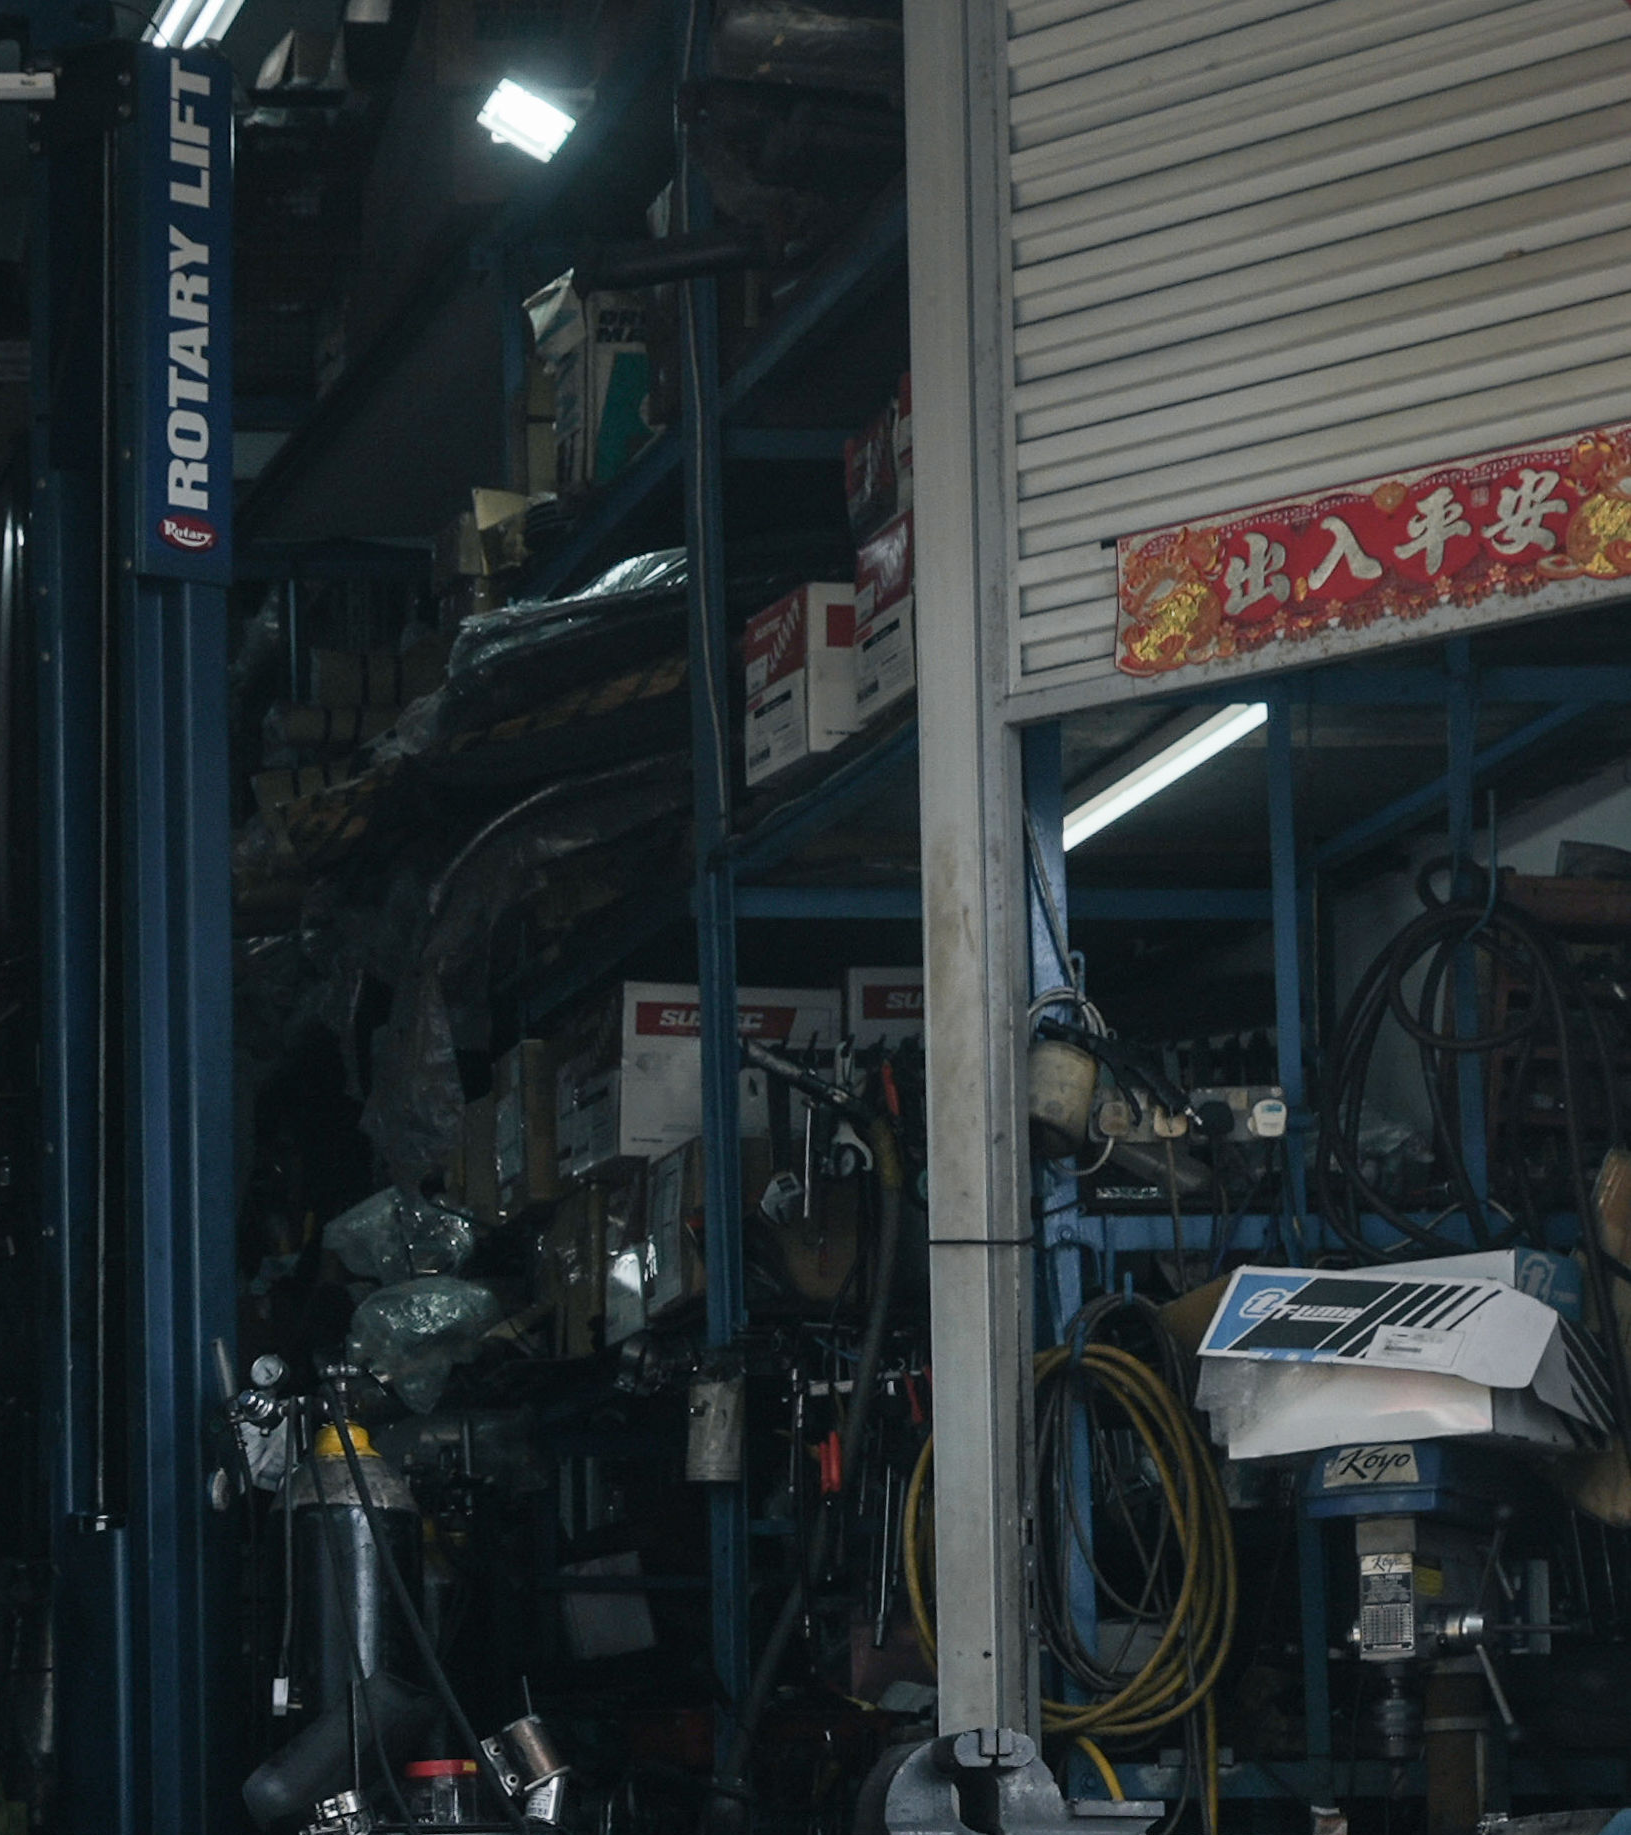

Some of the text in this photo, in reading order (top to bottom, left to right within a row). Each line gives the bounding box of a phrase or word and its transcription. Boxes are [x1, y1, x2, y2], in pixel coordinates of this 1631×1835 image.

[168, 57, 213, 511] ROTARY LIFT
[163, 521, 213, 550] Rotary
[1221, 469, 1569, 620] 出入平安
[1339, 1446, 1412, 1481] Koyo
